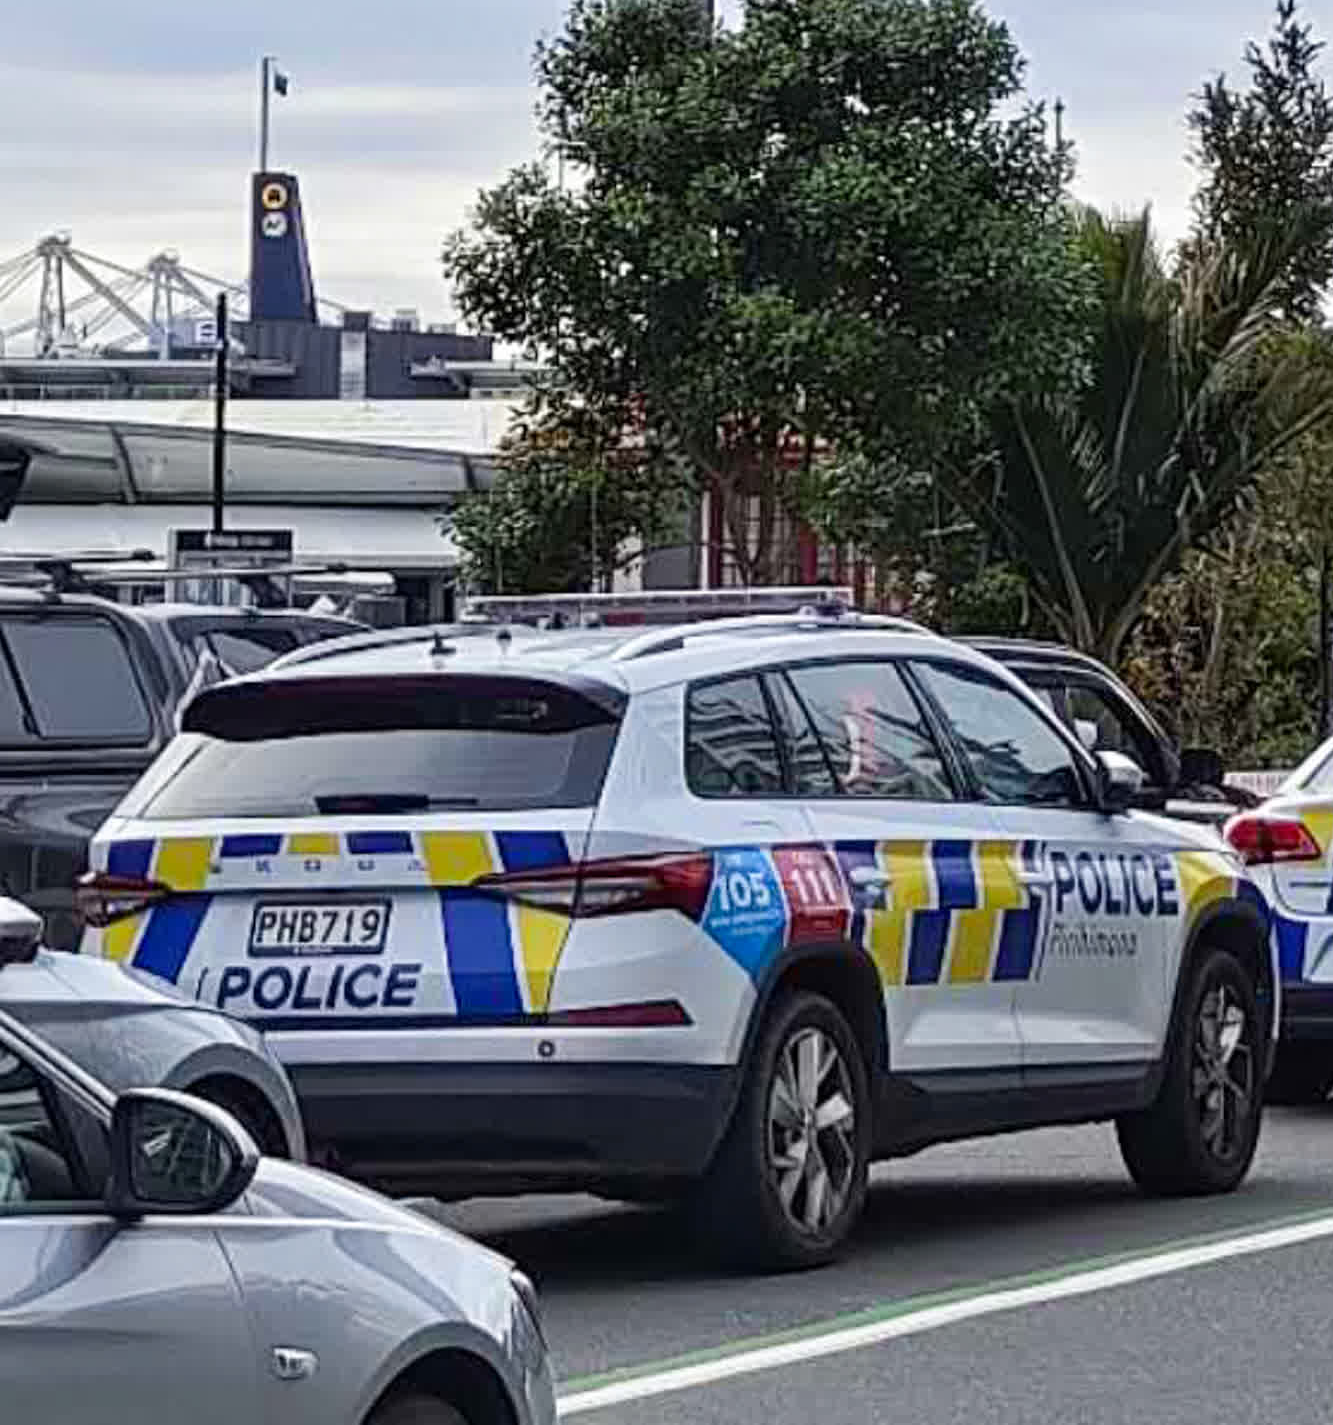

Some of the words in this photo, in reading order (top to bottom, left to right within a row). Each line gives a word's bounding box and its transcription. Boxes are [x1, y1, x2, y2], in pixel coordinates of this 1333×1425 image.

[713, 871, 770, 911] 105
[791, 869, 837, 904] 111
[1050, 851, 1179, 917] POLICE
[255, 909, 381, 944] PHB719
[216, 963, 423, 1010] POLICE
